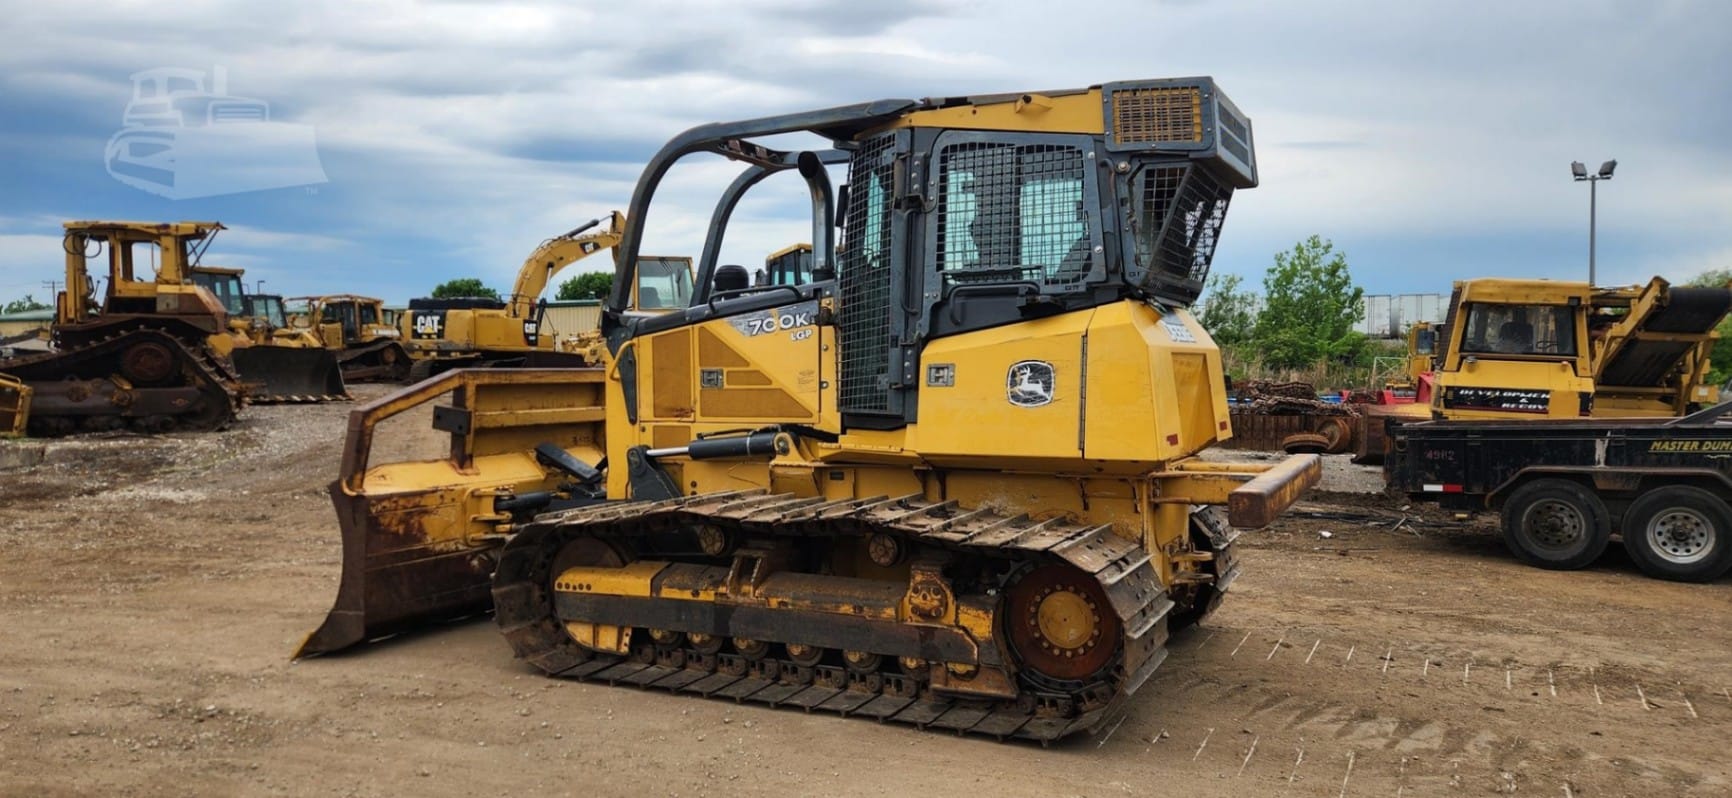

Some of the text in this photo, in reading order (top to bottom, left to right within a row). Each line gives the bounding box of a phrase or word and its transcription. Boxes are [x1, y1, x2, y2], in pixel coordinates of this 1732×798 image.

[417, 315, 440, 334] CAT
[524, 323, 536, 333] CAT
[749, 313, 809, 336] 700K
[791, 330, 812, 340] LGP
[1650, 441, 1732, 450] MASTER DUM
